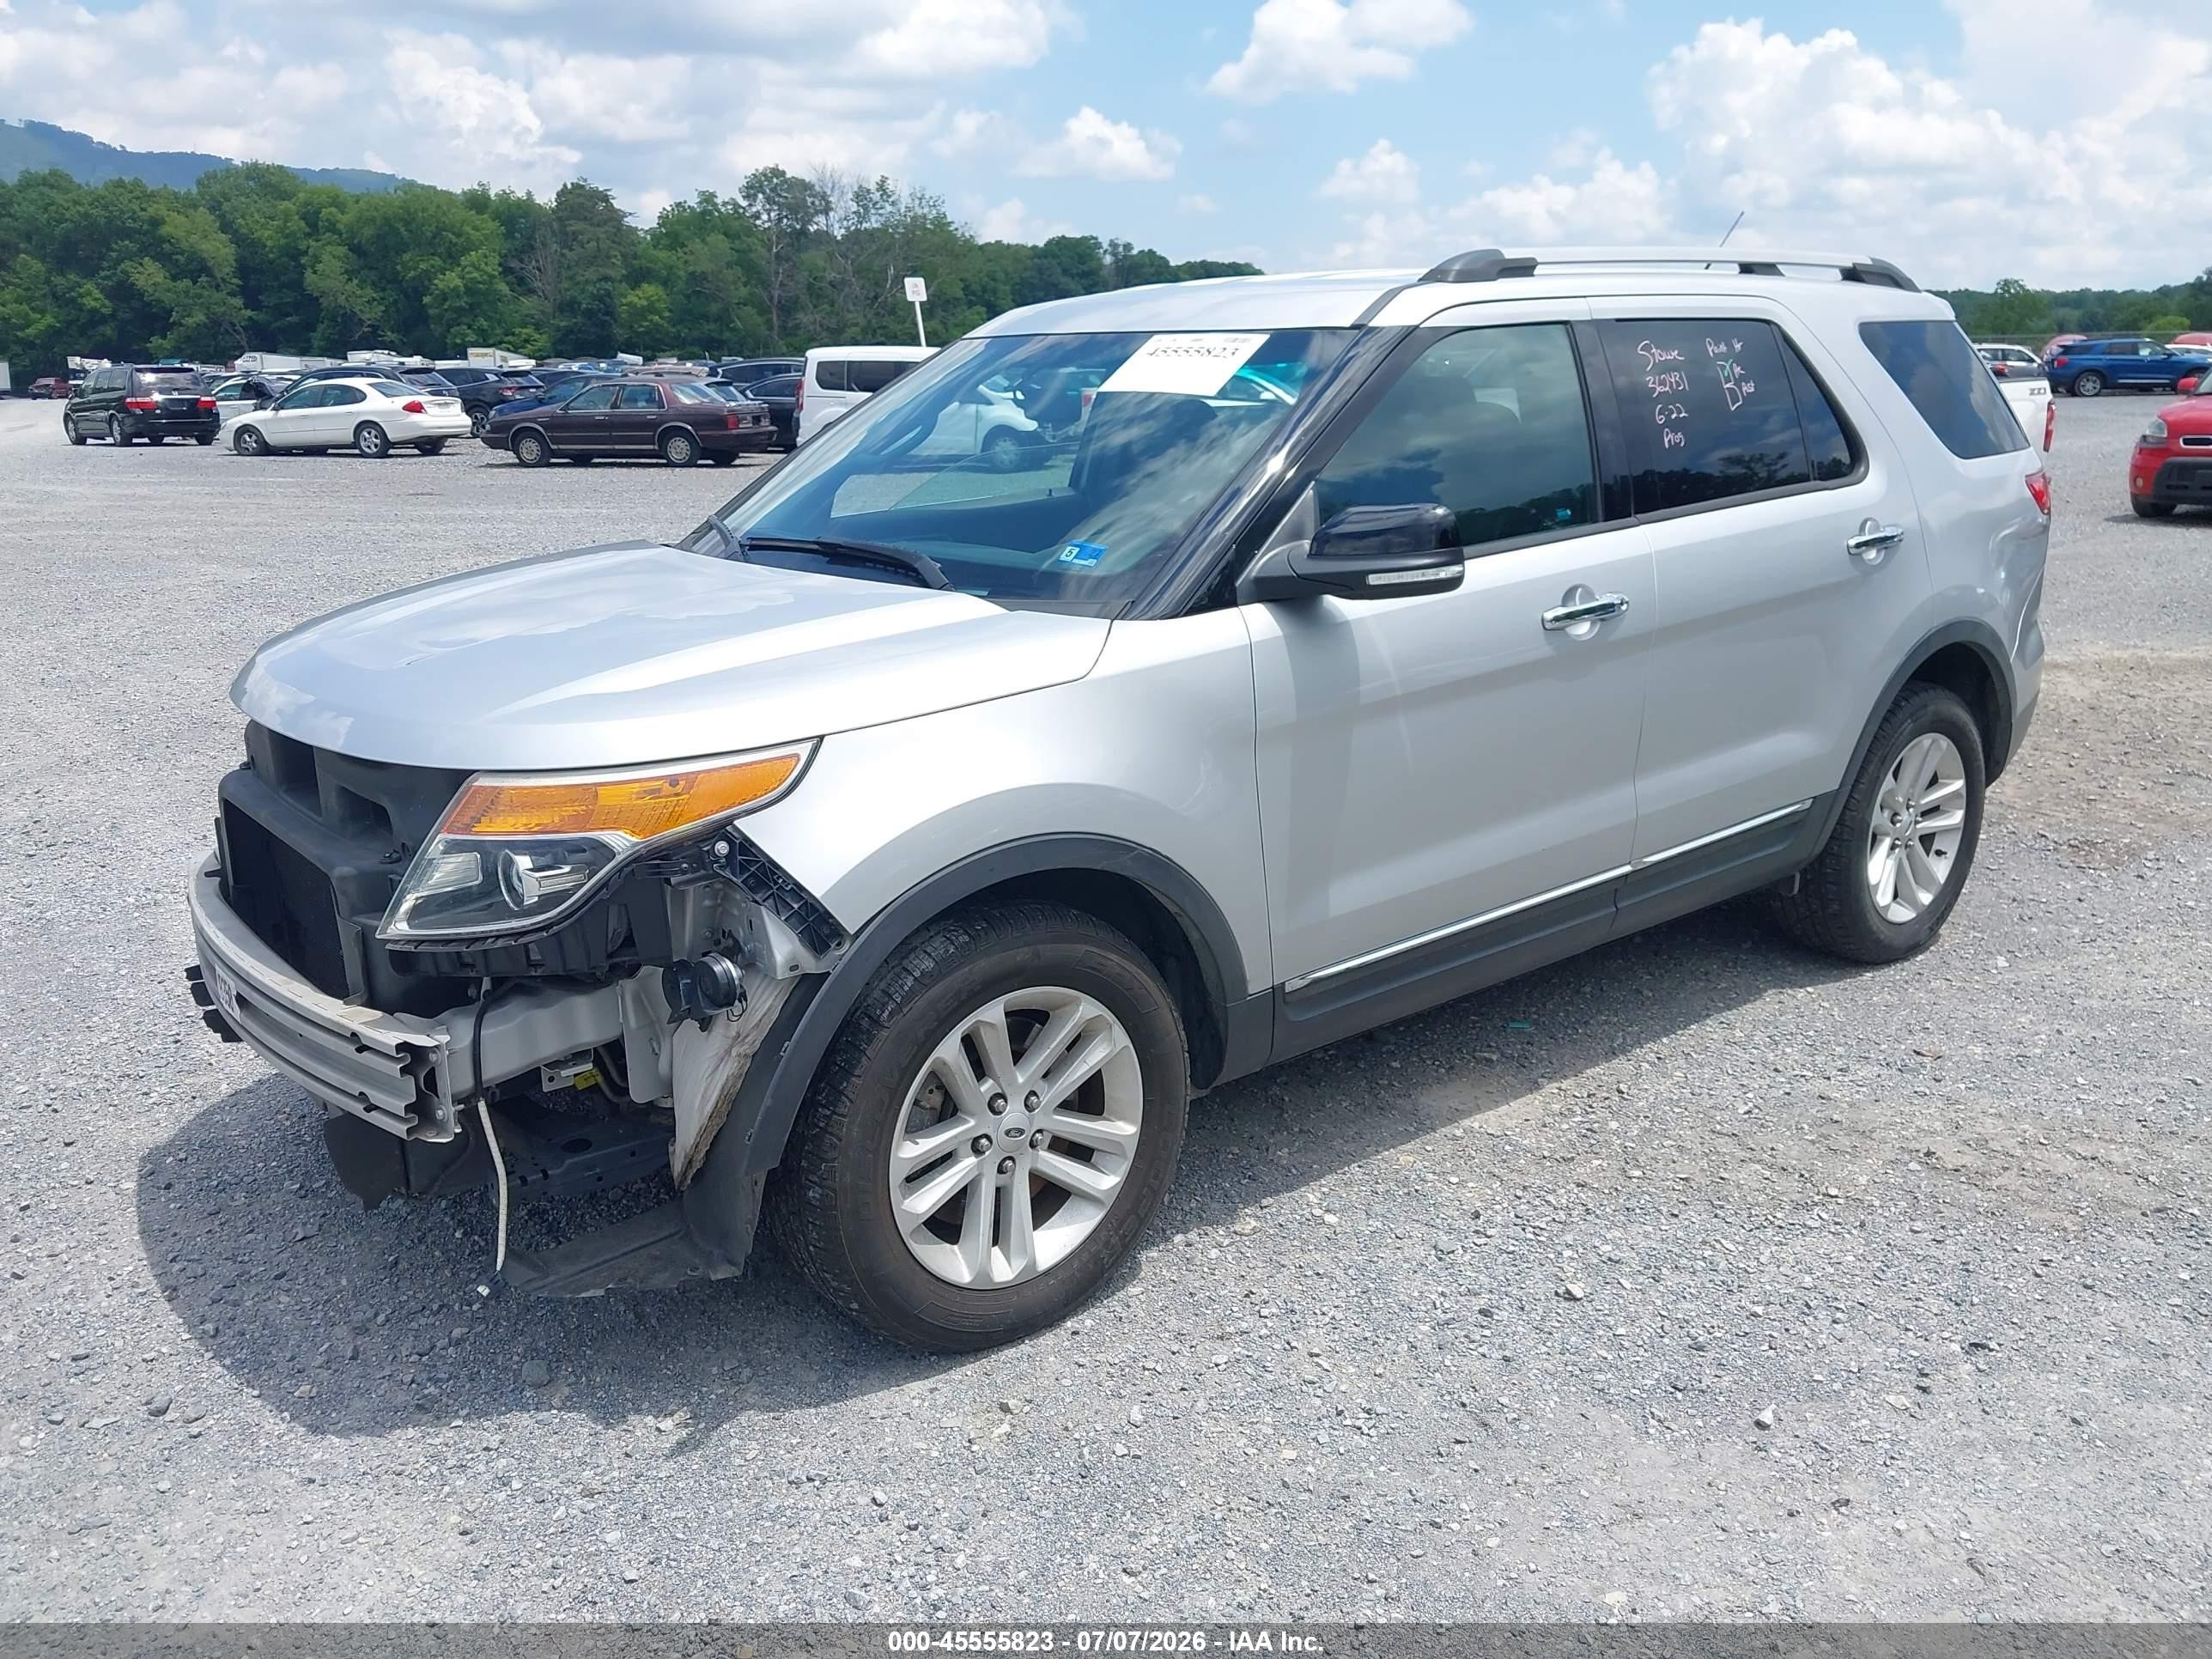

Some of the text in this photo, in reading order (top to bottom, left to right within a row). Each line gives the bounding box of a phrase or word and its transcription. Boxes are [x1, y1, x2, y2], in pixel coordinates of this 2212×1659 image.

[1147, 346, 1241, 358] 45555823
[1638, 340, 1685, 371] Stowe
[1646, 371, 1689, 398] 362431
[1065, 548, 1076, 557] 5
